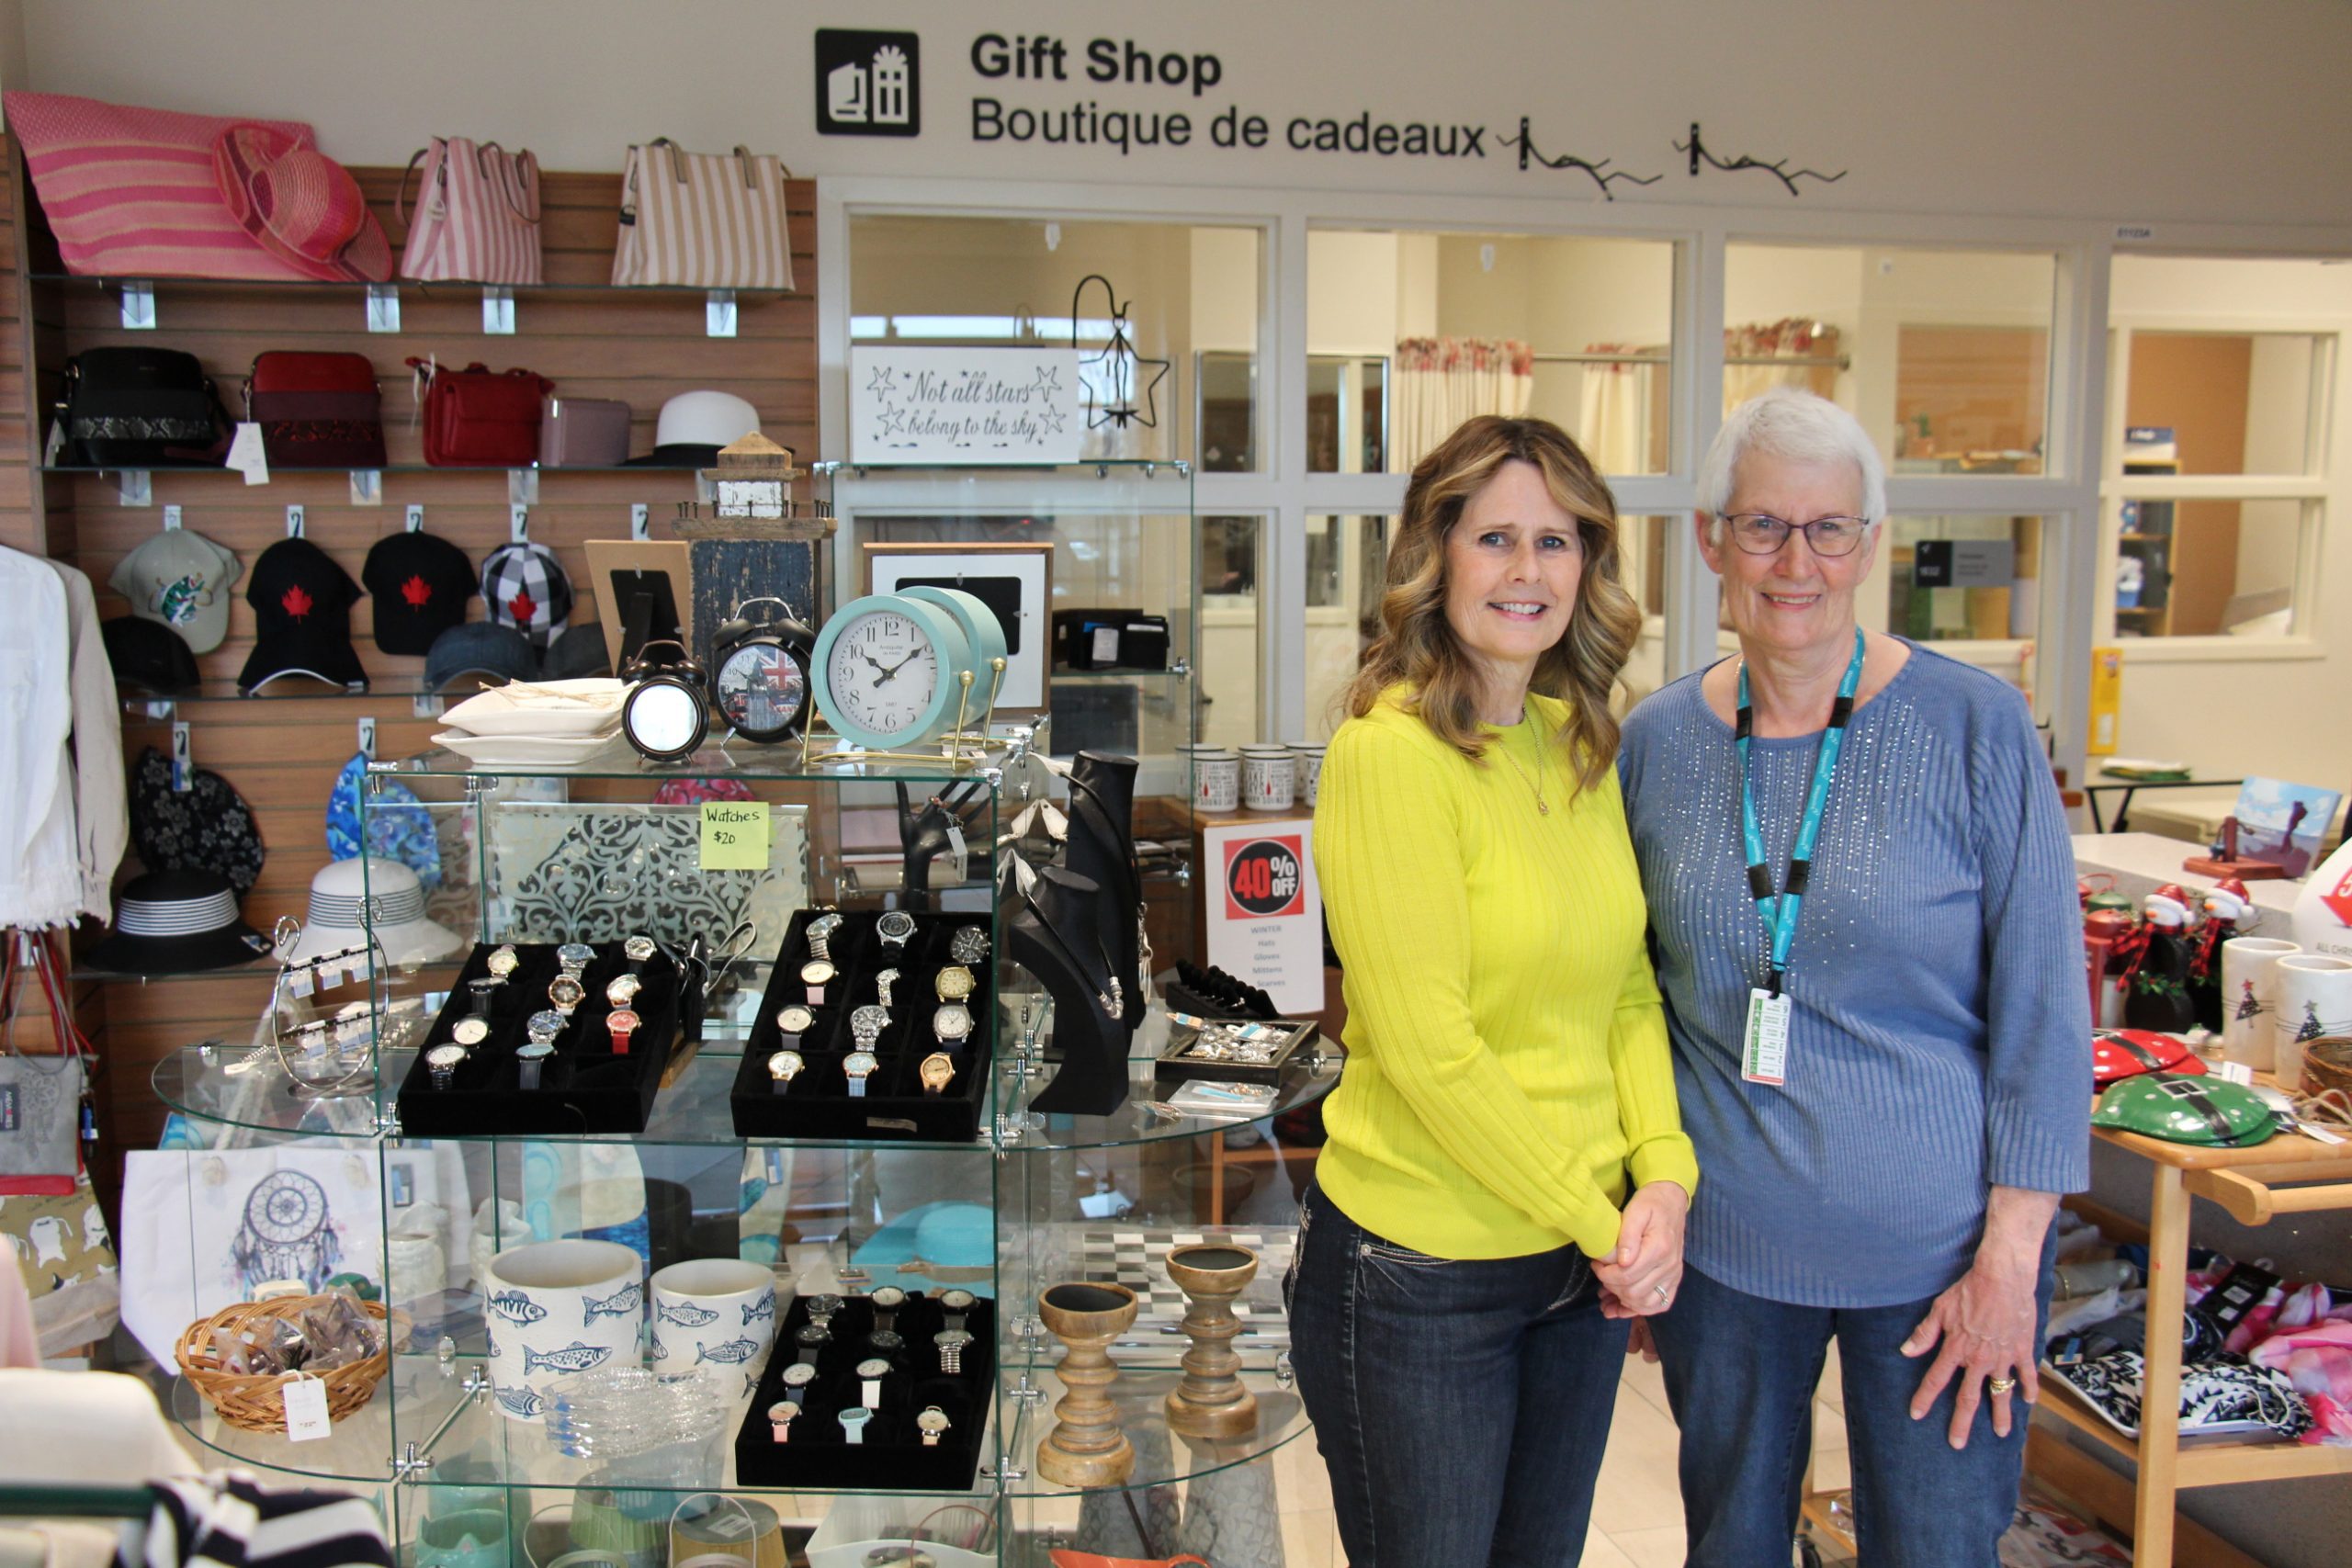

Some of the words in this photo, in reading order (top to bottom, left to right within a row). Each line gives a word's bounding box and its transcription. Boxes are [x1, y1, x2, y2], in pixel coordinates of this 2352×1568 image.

[970, 33, 1068, 79] Gift
[1085, 38, 1222, 96] Shop
[971, 97, 1193, 155] Boutique
[1210, 105, 1269, 147] de
[1286, 111, 1486, 157] cadeaux
[908, 370, 947, 402] Not
[952, 371, 987, 402] all
[985, 376, 1030, 403] stars
[908, 409, 961, 443] belong
[965, 416, 979, 435] to
[984, 411, 1008, 435] the
[1011, 411, 1037, 444] sky
[885, 621, 899, 637] 12
[850, 644, 863, 660] 10
[842, 667, 854, 682] 9
[849, 689, 860, 705] 8
[867, 706, 877, 723] 7
[885, 712, 897, 729] 6
[905, 707, 916, 724] 5
[707, 808, 760, 823] Watches
[714, 831, 735, 844] $20
[1234, 858, 1271, 899] 40
[1271, 856, 1295, 877] %
[1272, 877, 1295, 897] OFF
[1250, 925, 1282, 934] WINTER
[2316, 942, 2329, 953] ALL
[1254, 953, 1280, 962] Gloves
